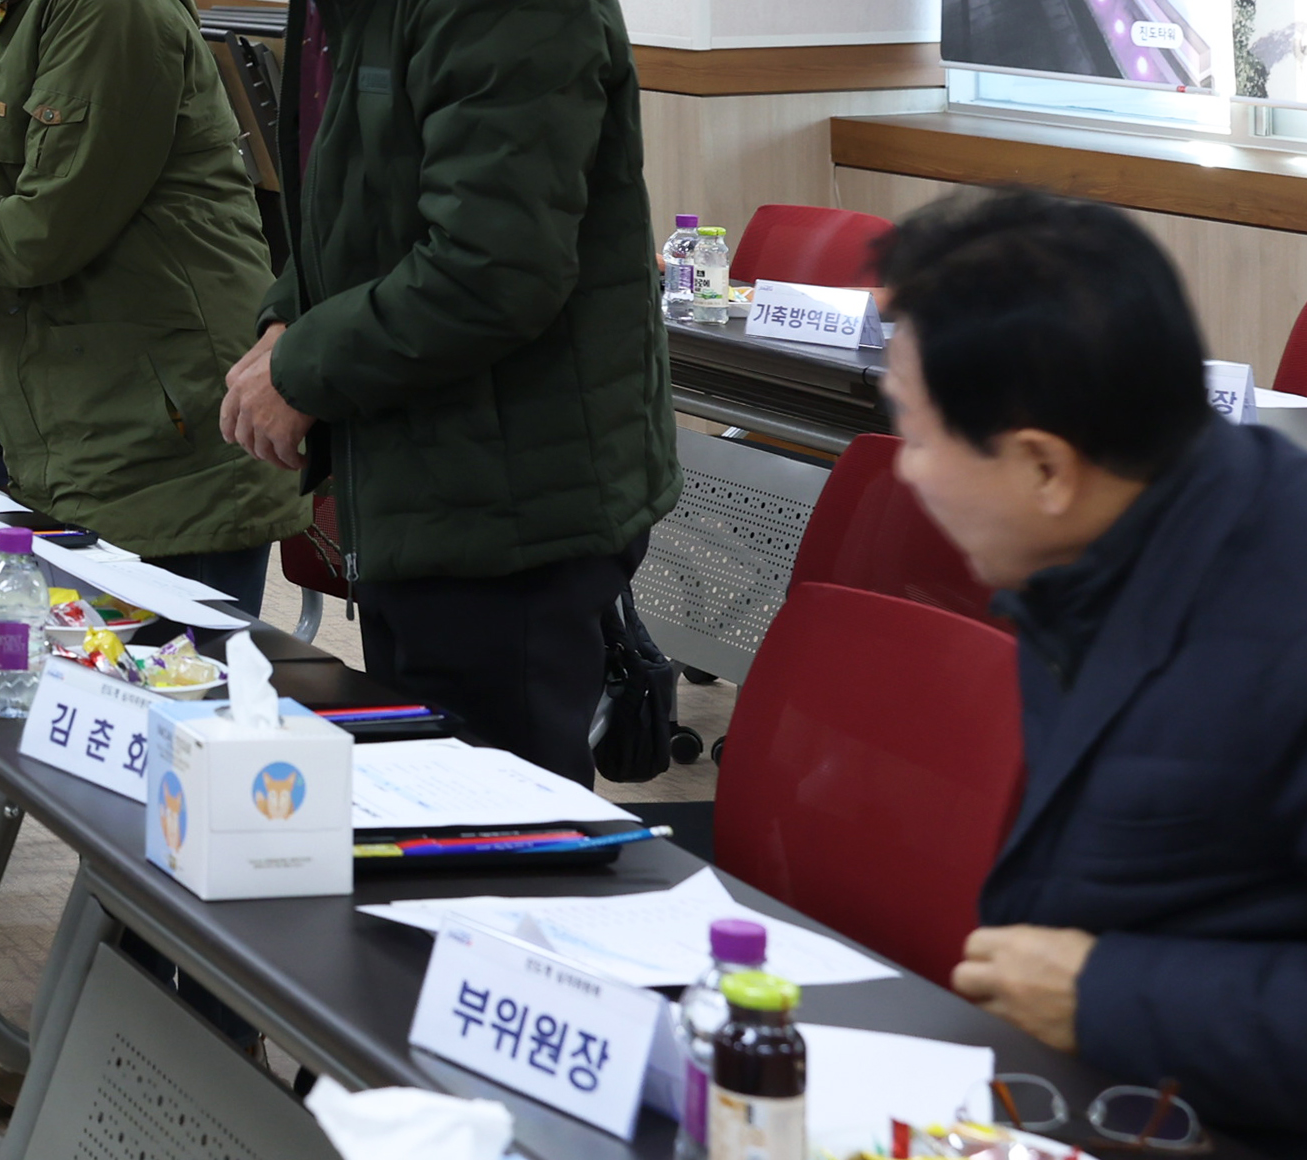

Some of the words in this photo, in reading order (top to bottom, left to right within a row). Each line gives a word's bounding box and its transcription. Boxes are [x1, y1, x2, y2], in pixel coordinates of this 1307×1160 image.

[1139, 26, 1175, 41] 진도타워
[753, 303, 859, 337] 가축방역팀장
[452, 979, 610, 1092] 부위원장
